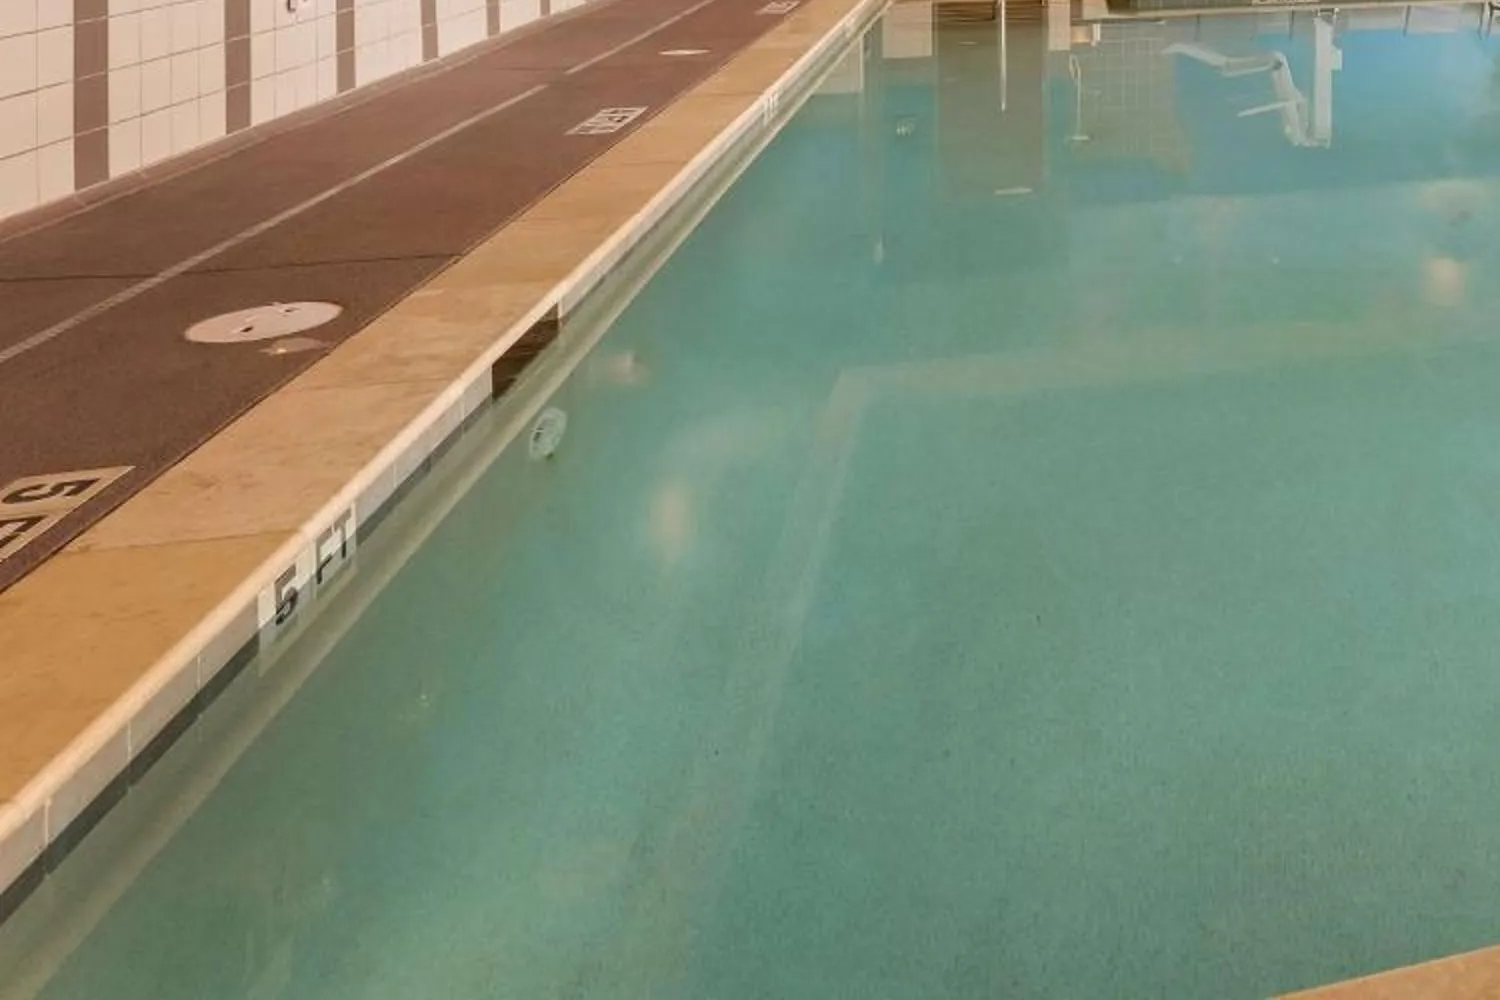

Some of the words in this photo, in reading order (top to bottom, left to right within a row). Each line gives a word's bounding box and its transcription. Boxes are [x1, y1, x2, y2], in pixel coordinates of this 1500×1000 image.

[3, 478, 101, 504] 5
[274, 562, 299, 625] 5
[316, 507, 352, 585] FT
